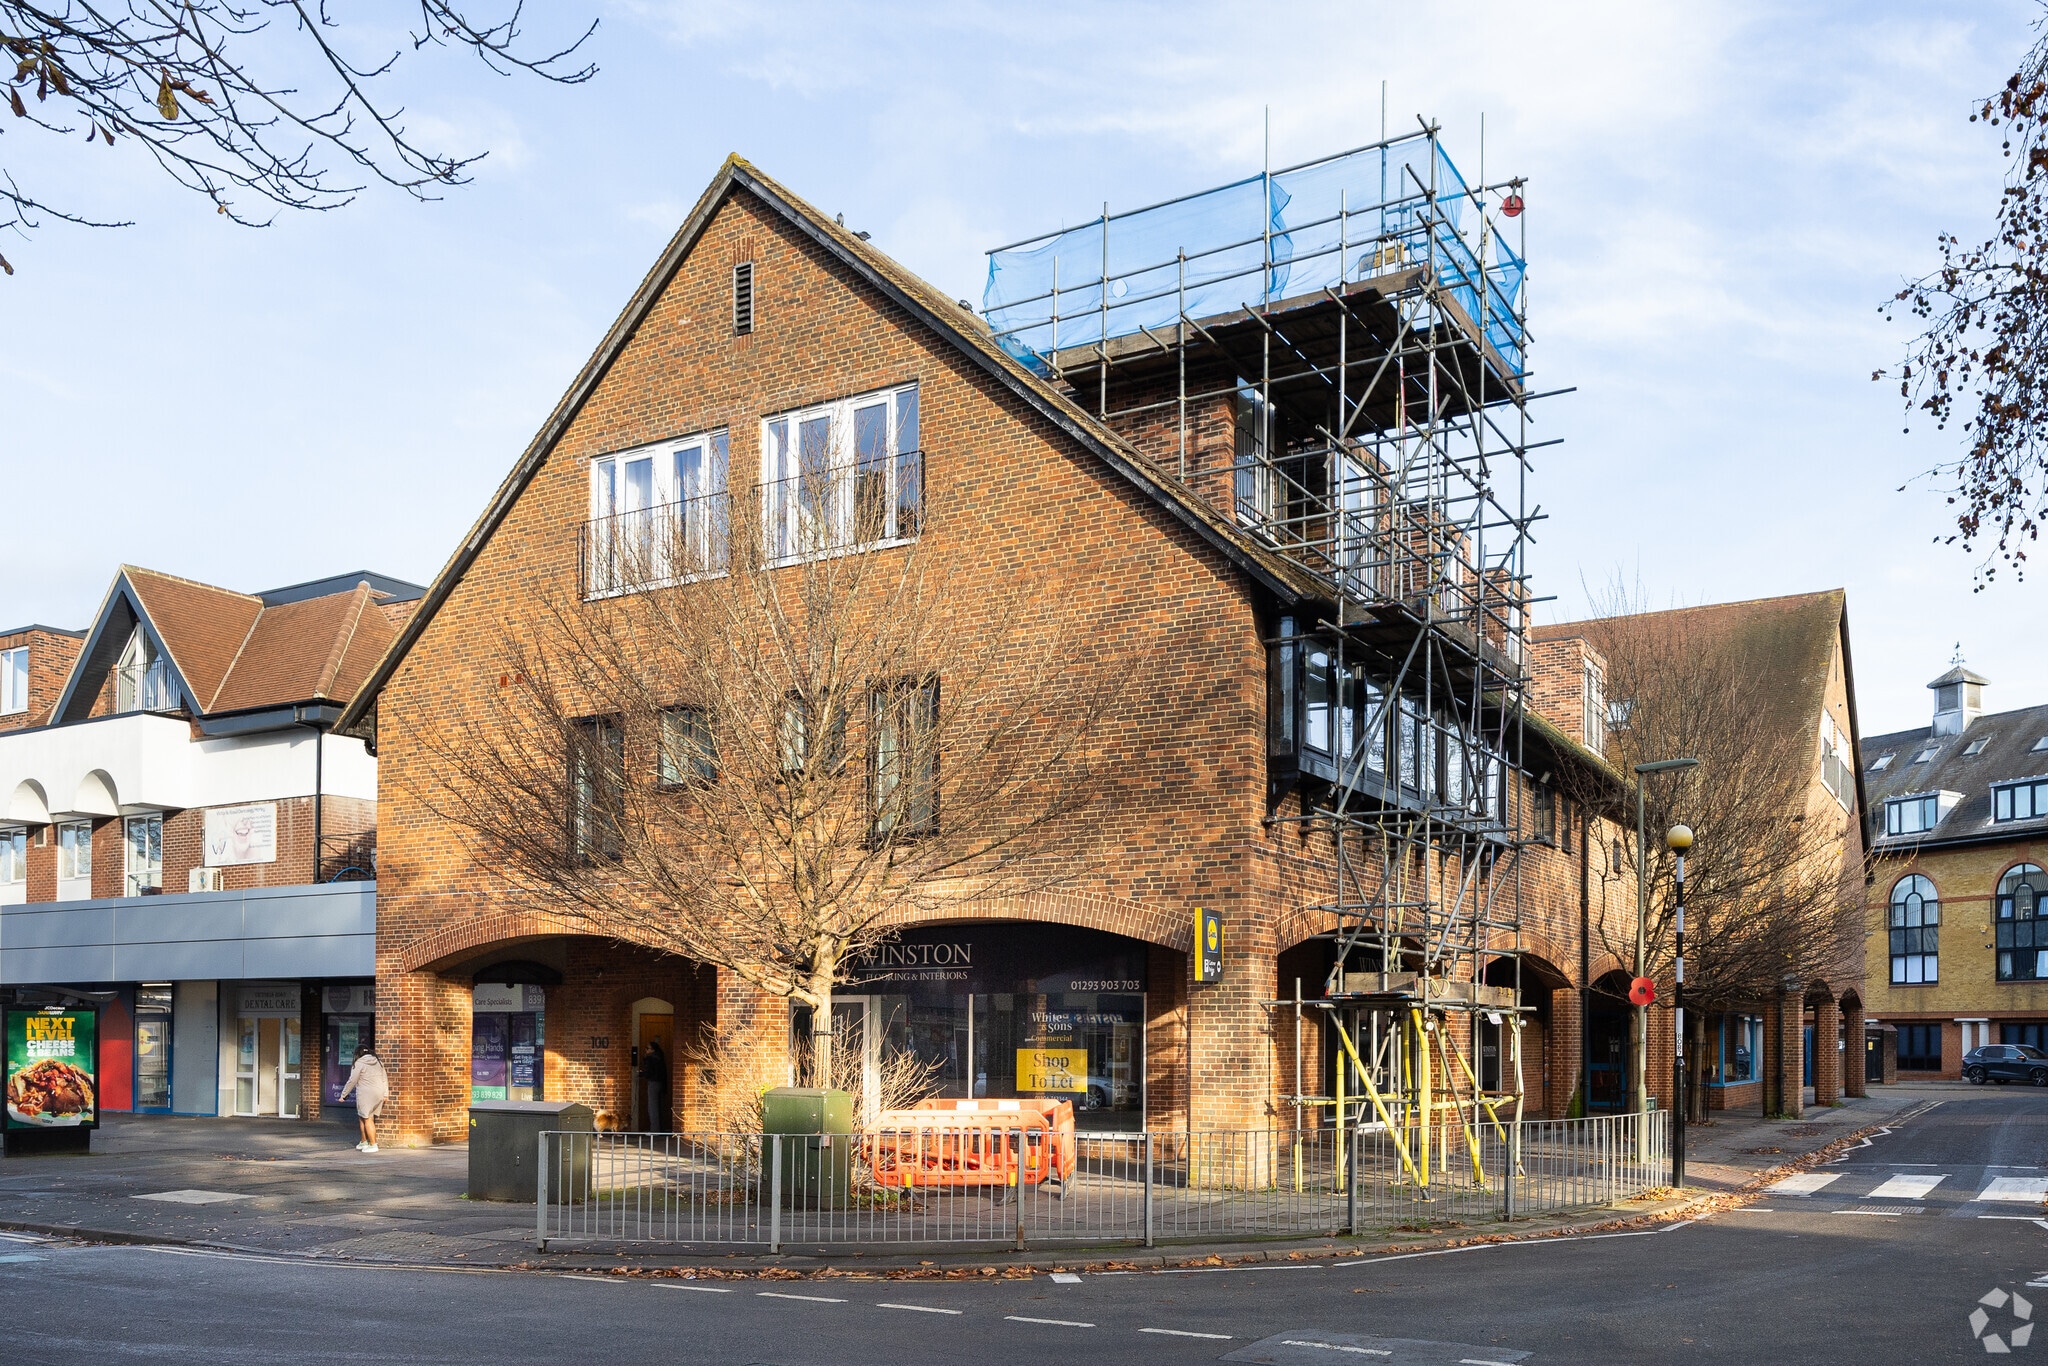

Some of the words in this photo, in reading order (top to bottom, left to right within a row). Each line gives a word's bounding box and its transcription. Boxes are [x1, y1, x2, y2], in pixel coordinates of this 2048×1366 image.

[859, 943, 973, 966] WINSTON
[866, 972, 911, 981] FLOORING
[919, 971, 968, 980] INTERIORS
[1070, 980, 1099, 991] 01293
[1100, 980, 1119, 990] 903
[1121, 980, 1140, 990] 703
[244, 999, 273, 1009] DENTAL
[275, 999, 296, 1009] CARE
[26, 1017, 76, 1030] NEXT
[26, 1029, 75, 1041] LEVEL
[26, 1040, 75, 1049] CHEESE
[485, 1042, 504, 1052] Hands
[591, 1036, 609, 1049] 100
[26, 1049, 37, 1057] &
[37, 1049, 75, 1057] BEANS
[1033, 1053, 1070, 1071] Shop
[1029, 1074, 1047, 1089] To
[1051, 1074, 1074, 1089] Let
